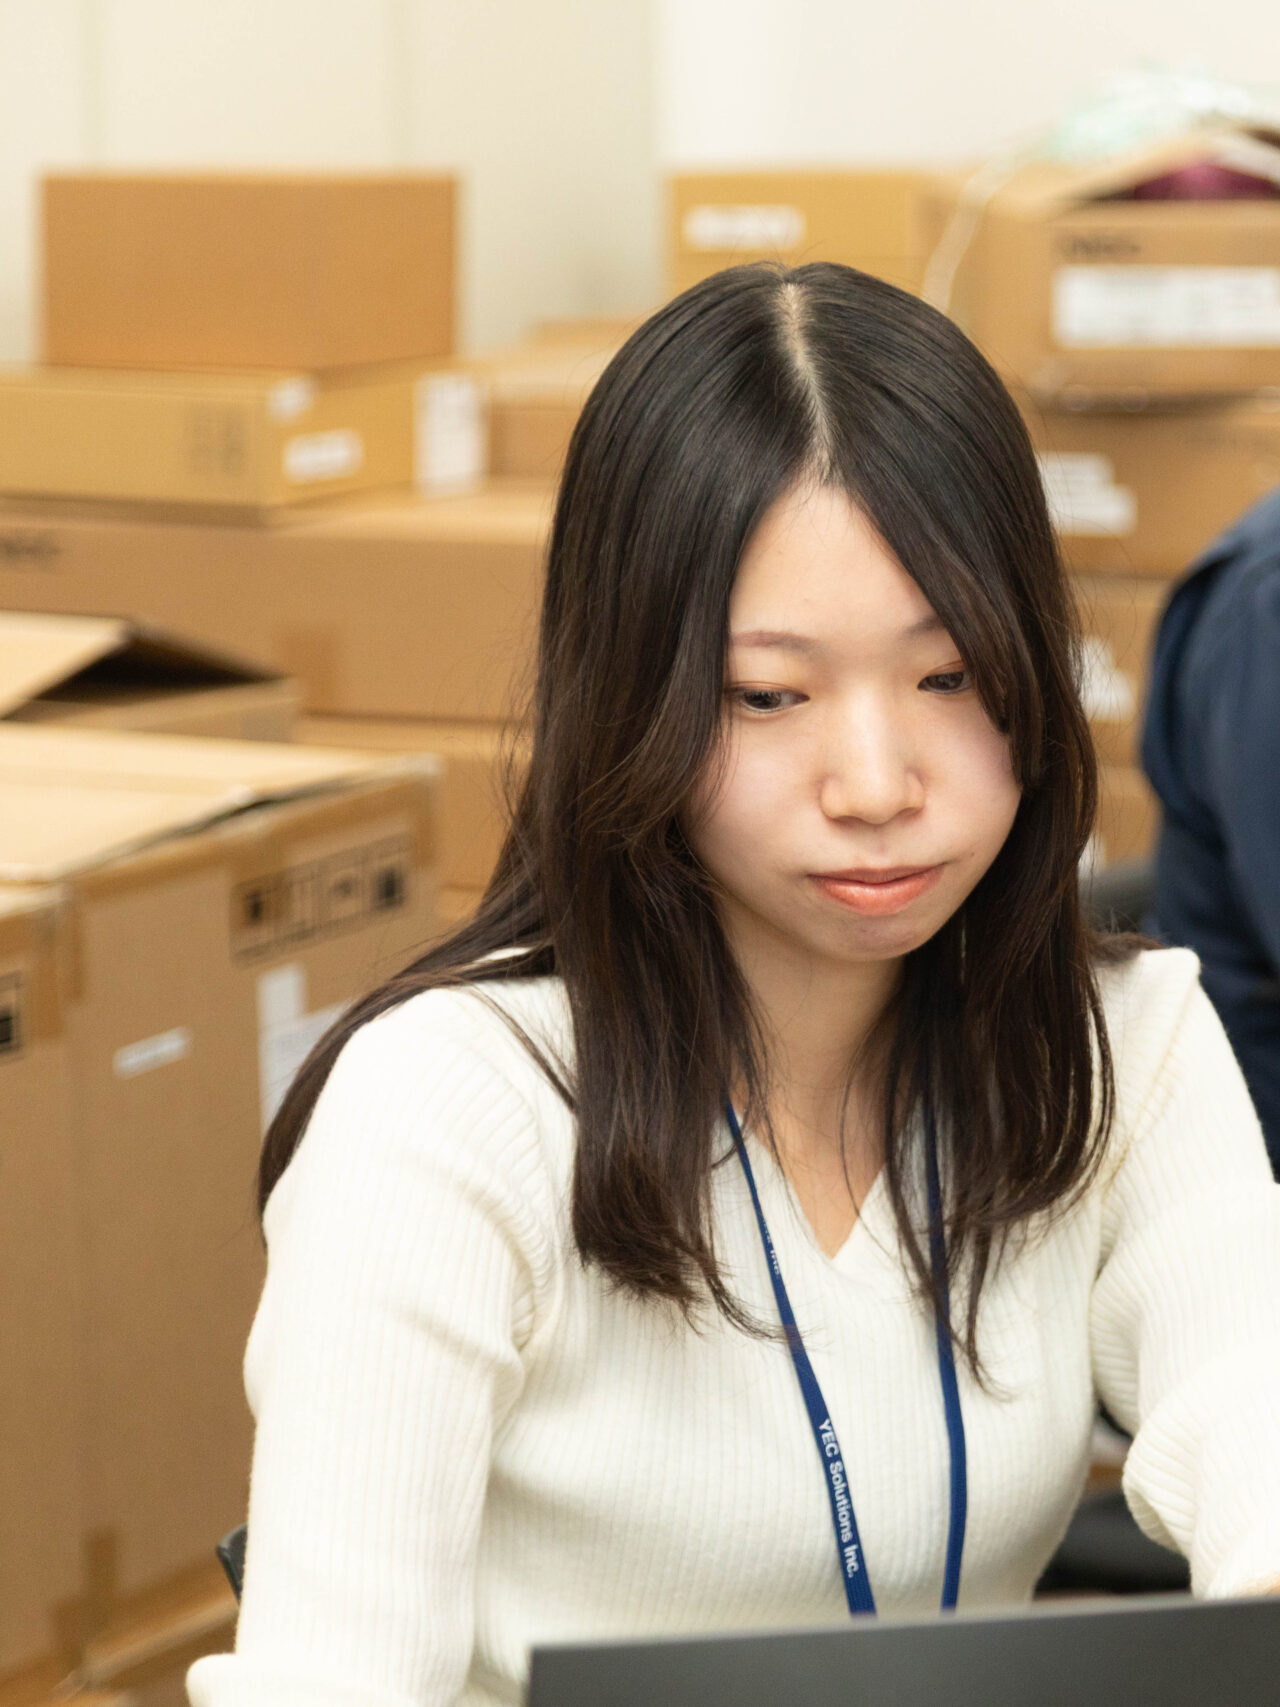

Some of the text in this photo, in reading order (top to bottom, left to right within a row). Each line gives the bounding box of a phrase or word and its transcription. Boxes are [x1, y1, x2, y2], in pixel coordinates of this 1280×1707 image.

[819, 1418, 859, 1578] YEC Solutions Inc.
